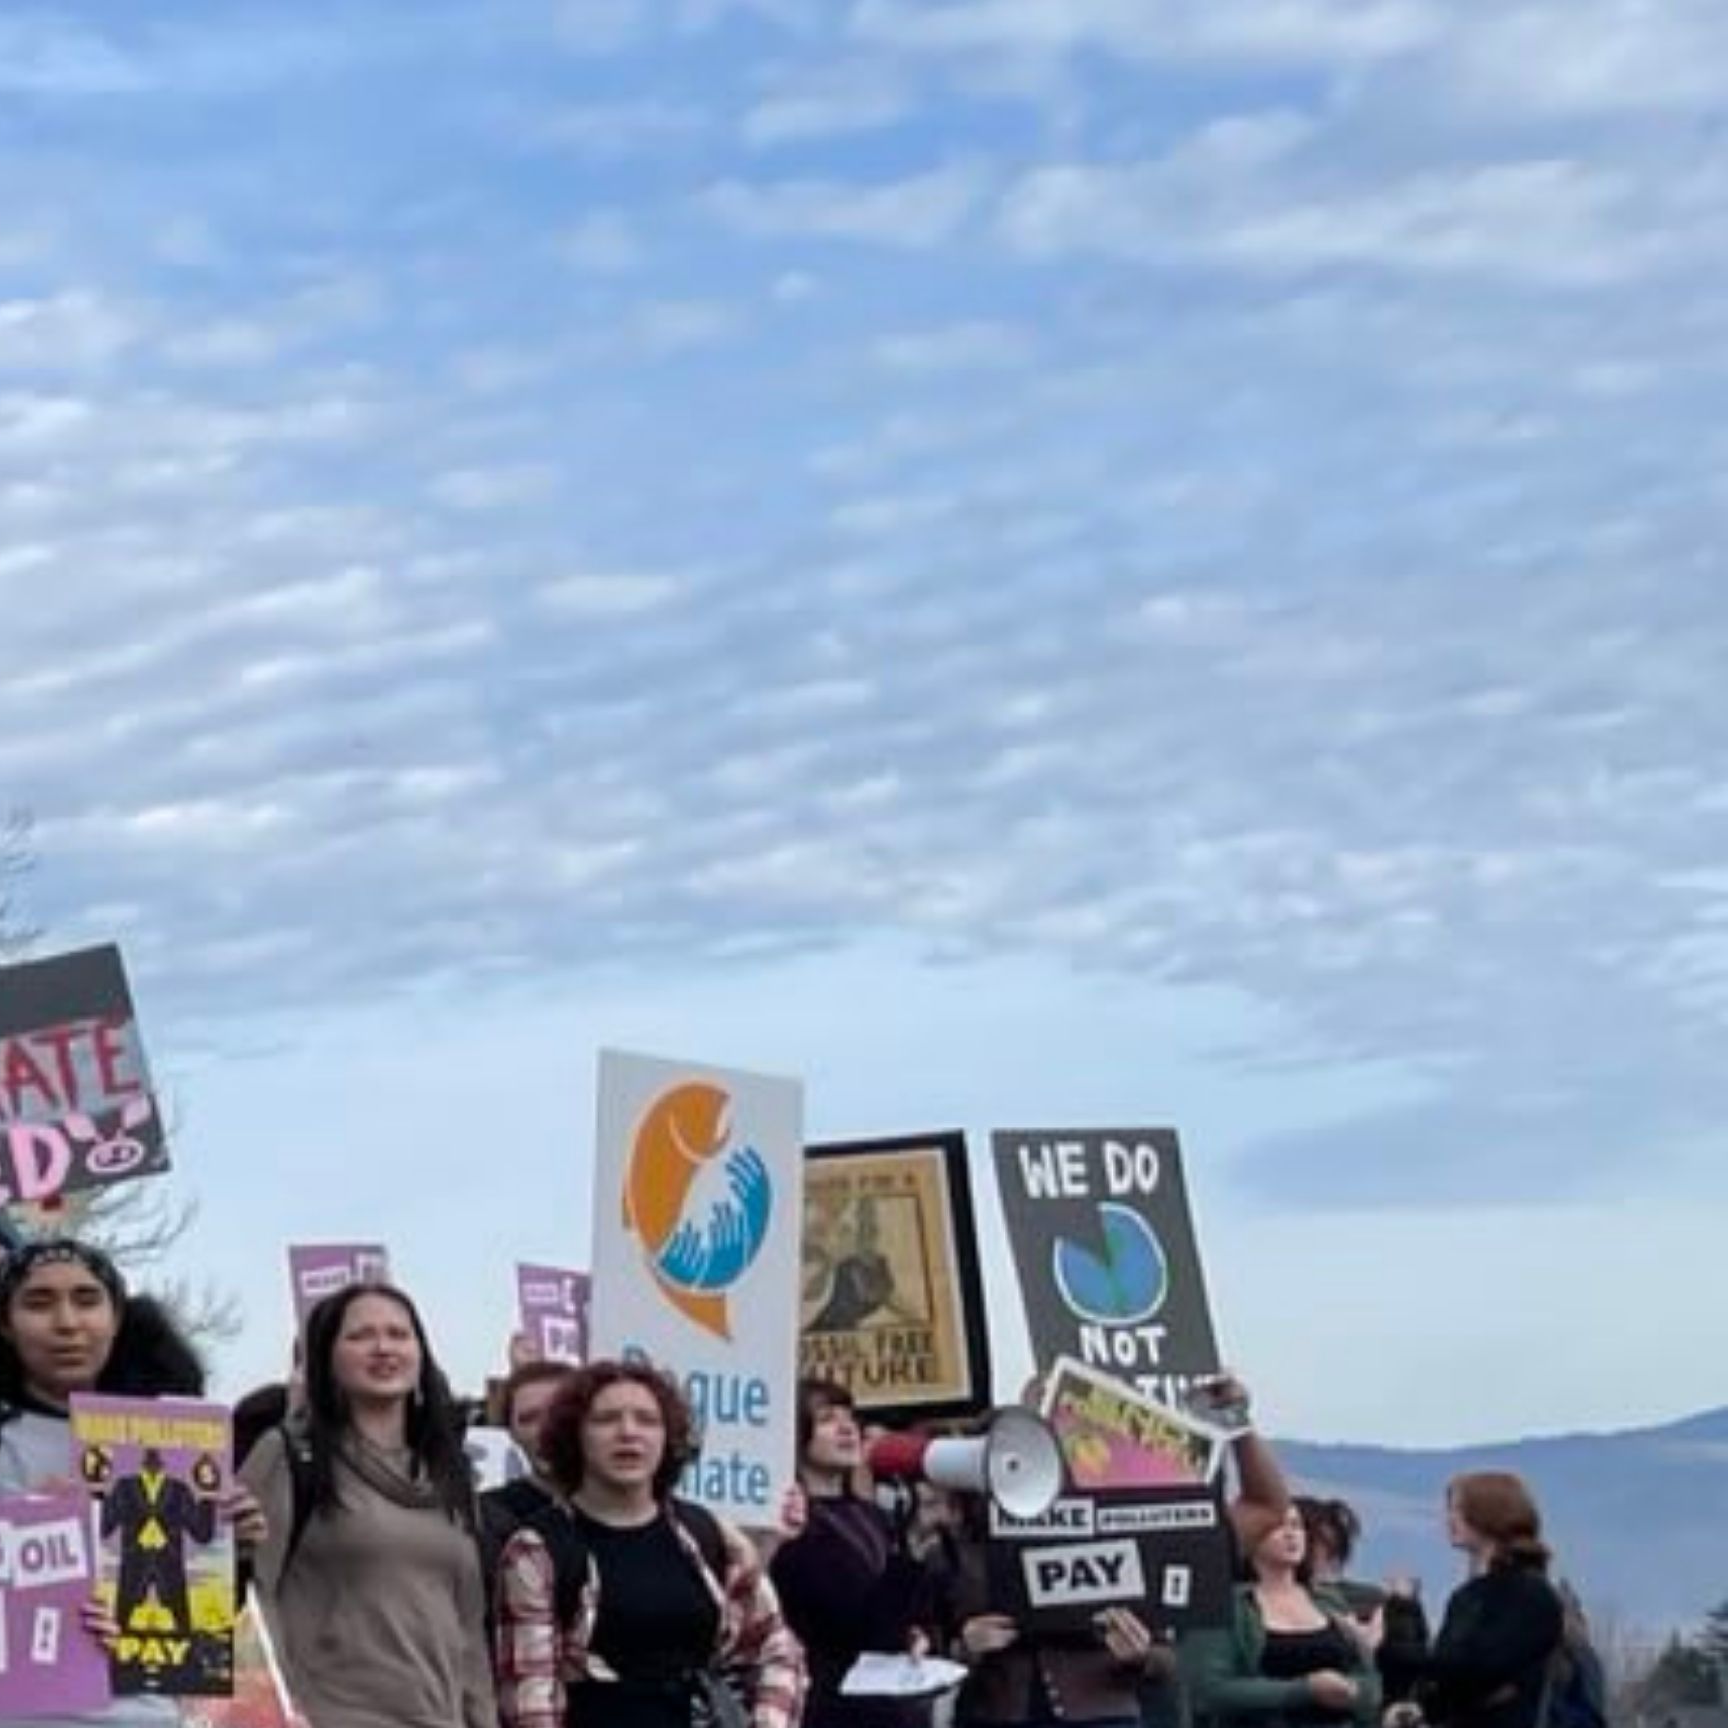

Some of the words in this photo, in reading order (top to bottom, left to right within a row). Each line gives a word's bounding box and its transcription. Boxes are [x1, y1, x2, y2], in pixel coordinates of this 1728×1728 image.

[1018, 1143, 1089, 1199] WE
[1105, 1140, 1159, 1195] DO
[1079, 1325, 1166, 1365] NOT
[20, 1533, 78, 1573] OIL
[1037, 1553, 1124, 1591] PAY
[116, 1636, 191, 1667] PAY
